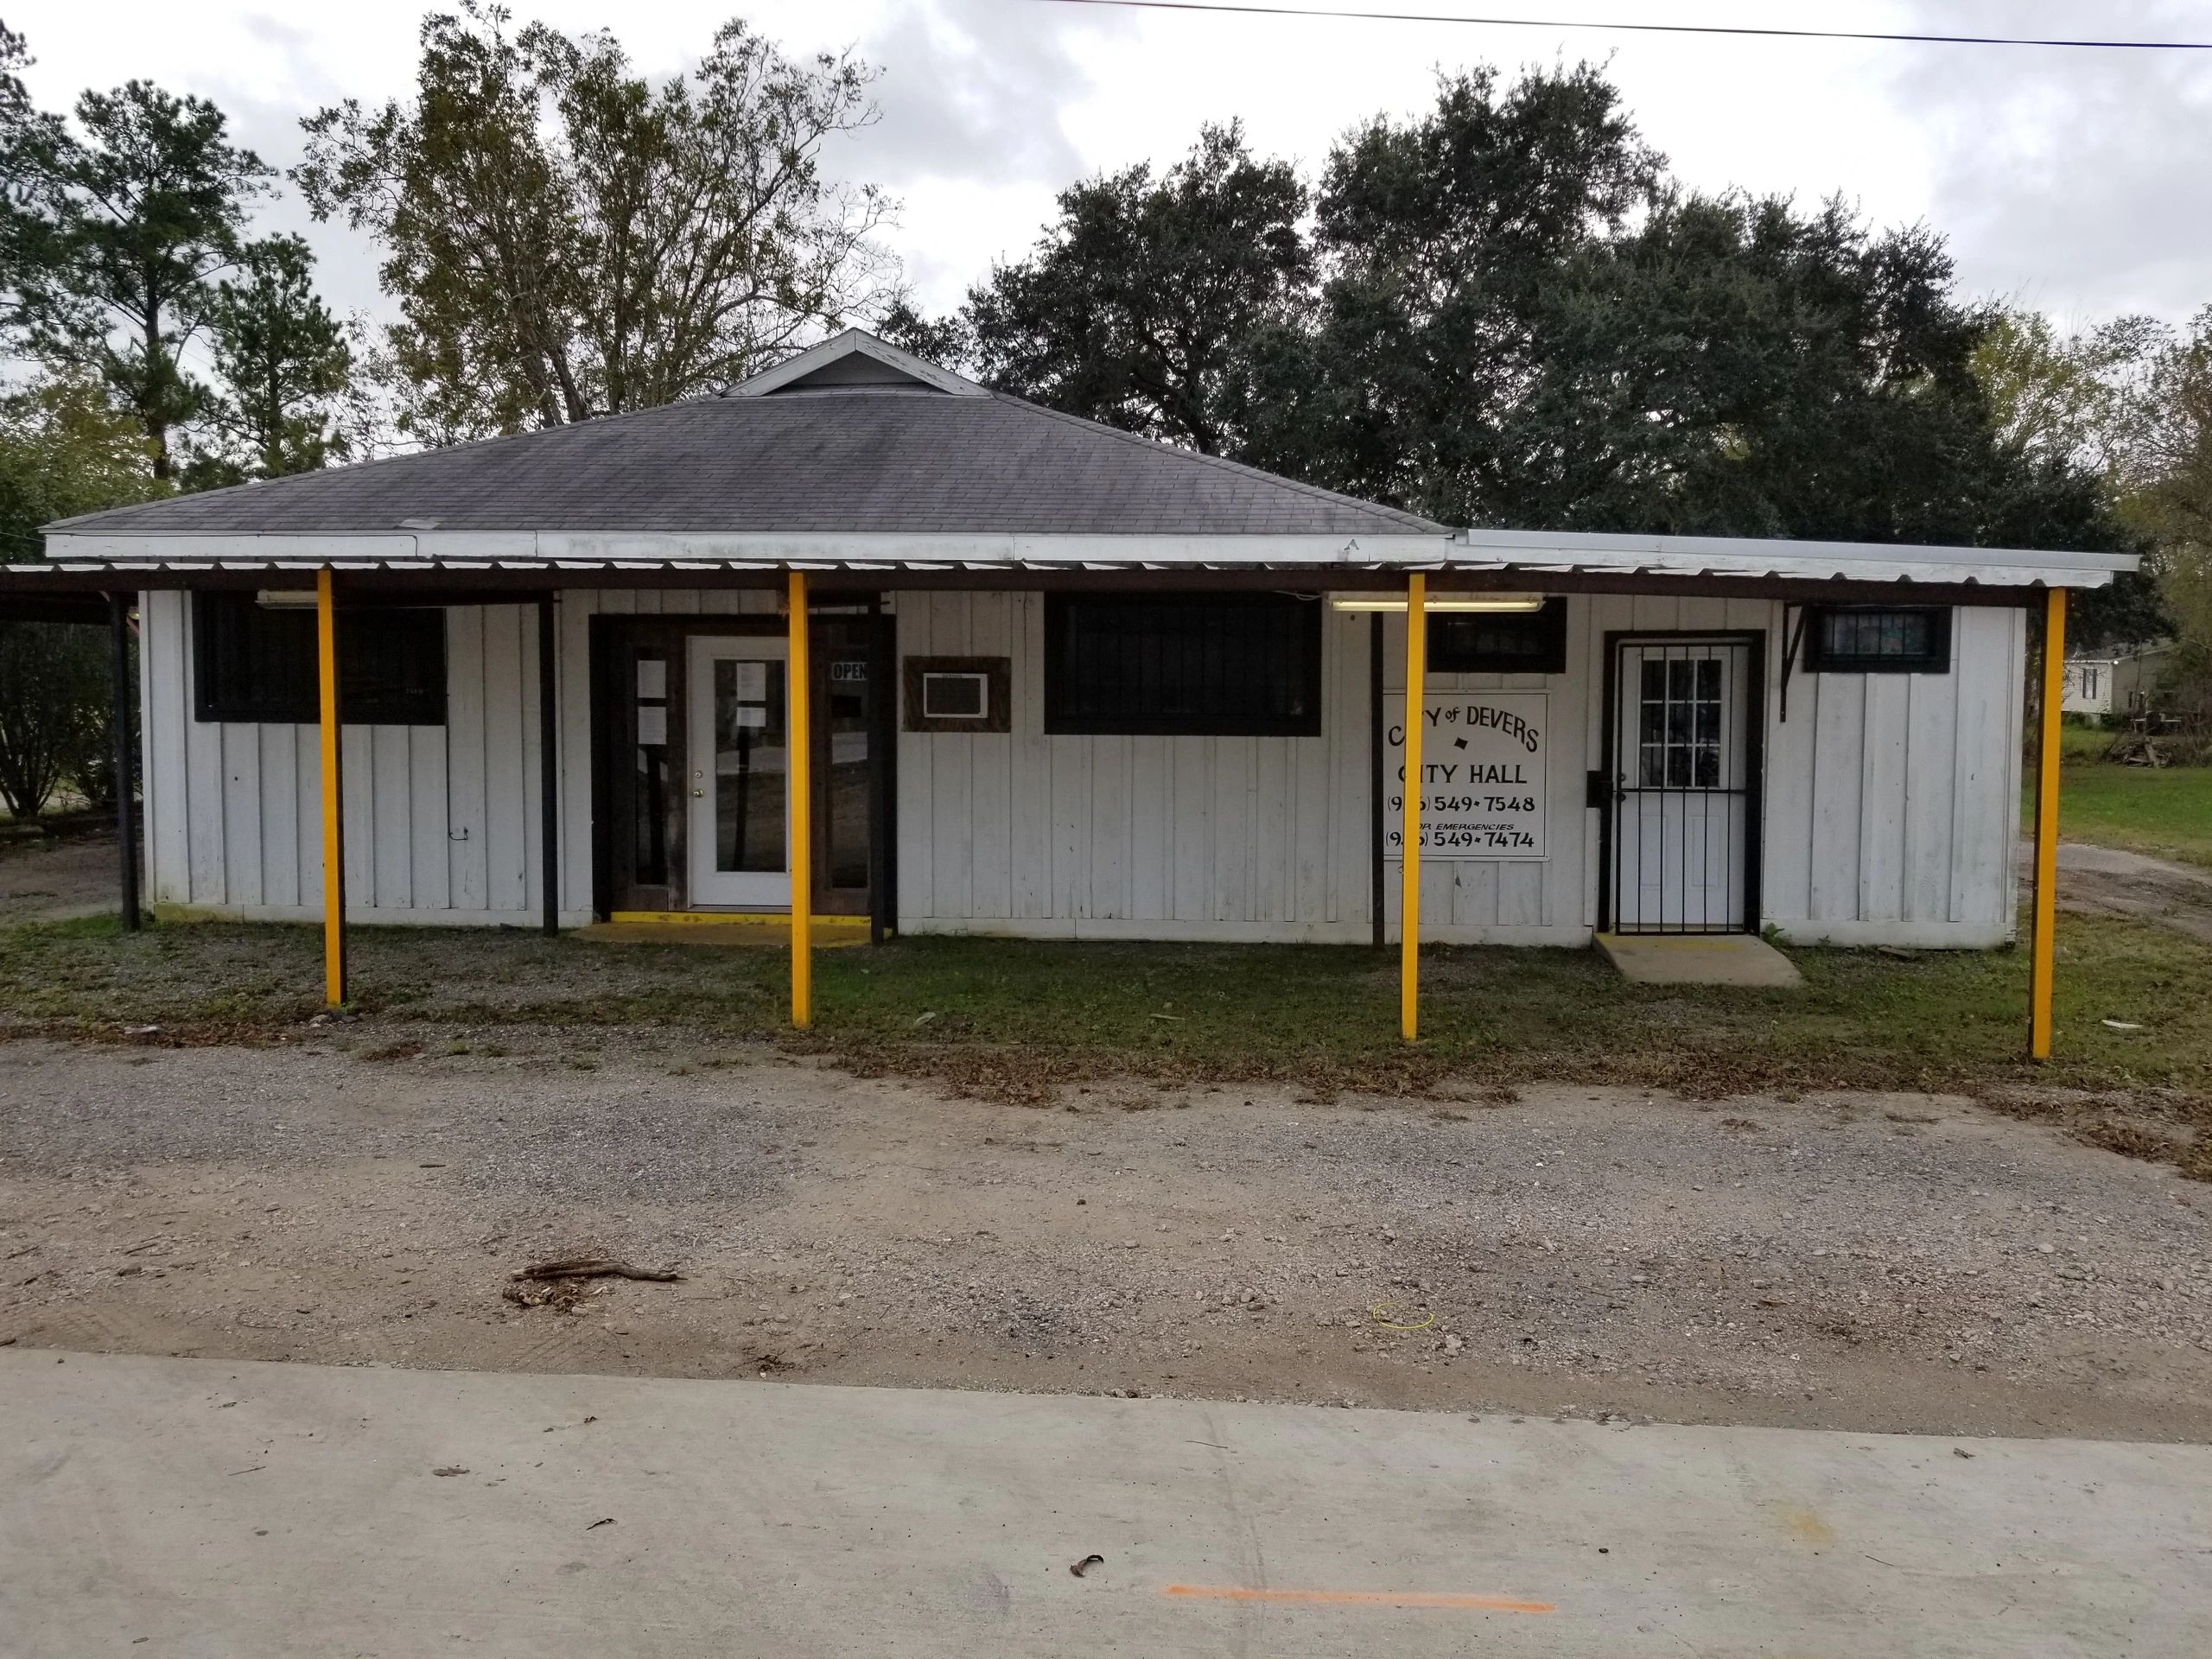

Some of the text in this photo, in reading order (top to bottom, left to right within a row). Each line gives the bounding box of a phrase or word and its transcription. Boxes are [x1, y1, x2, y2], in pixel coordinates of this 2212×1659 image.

[833, 663, 866, 679] OPEN
[1389, 706, 1539, 753] CY of DEVERS
[1470, 765, 1527, 784] HALL
[1388, 796, 1430, 811] (96)
[1386, 832, 1428, 847] (96)
